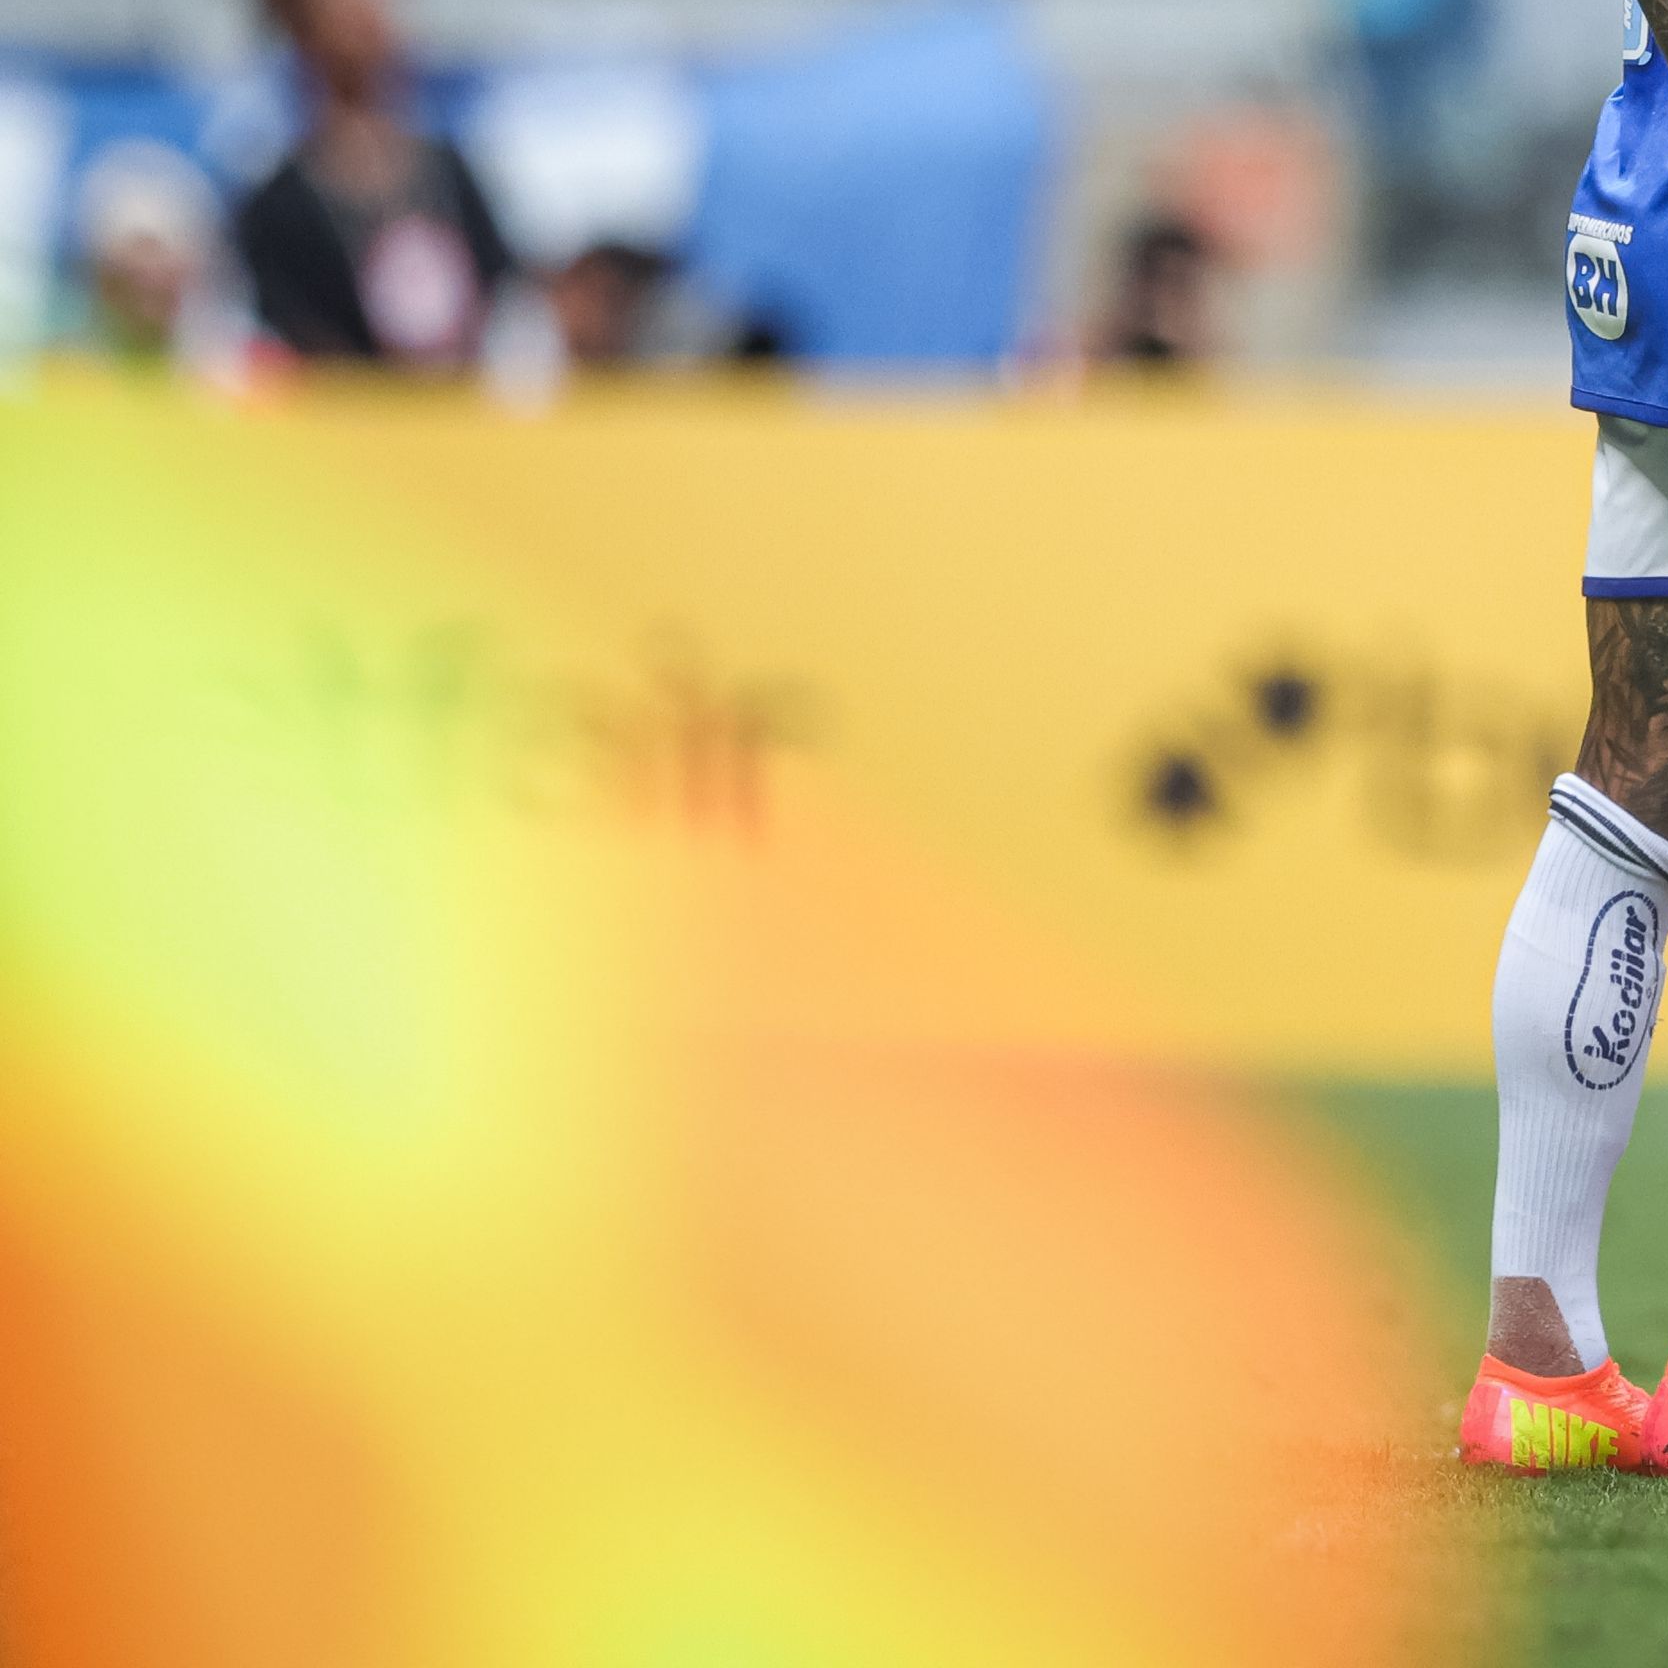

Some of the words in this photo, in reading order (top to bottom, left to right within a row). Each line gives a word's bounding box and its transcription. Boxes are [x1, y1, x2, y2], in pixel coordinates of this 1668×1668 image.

[1573, 251, 1619, 318] BH
[1584, 905, 1647, 1066] Kodilar
[1510, 1398, 1619, 1469] NIKE
